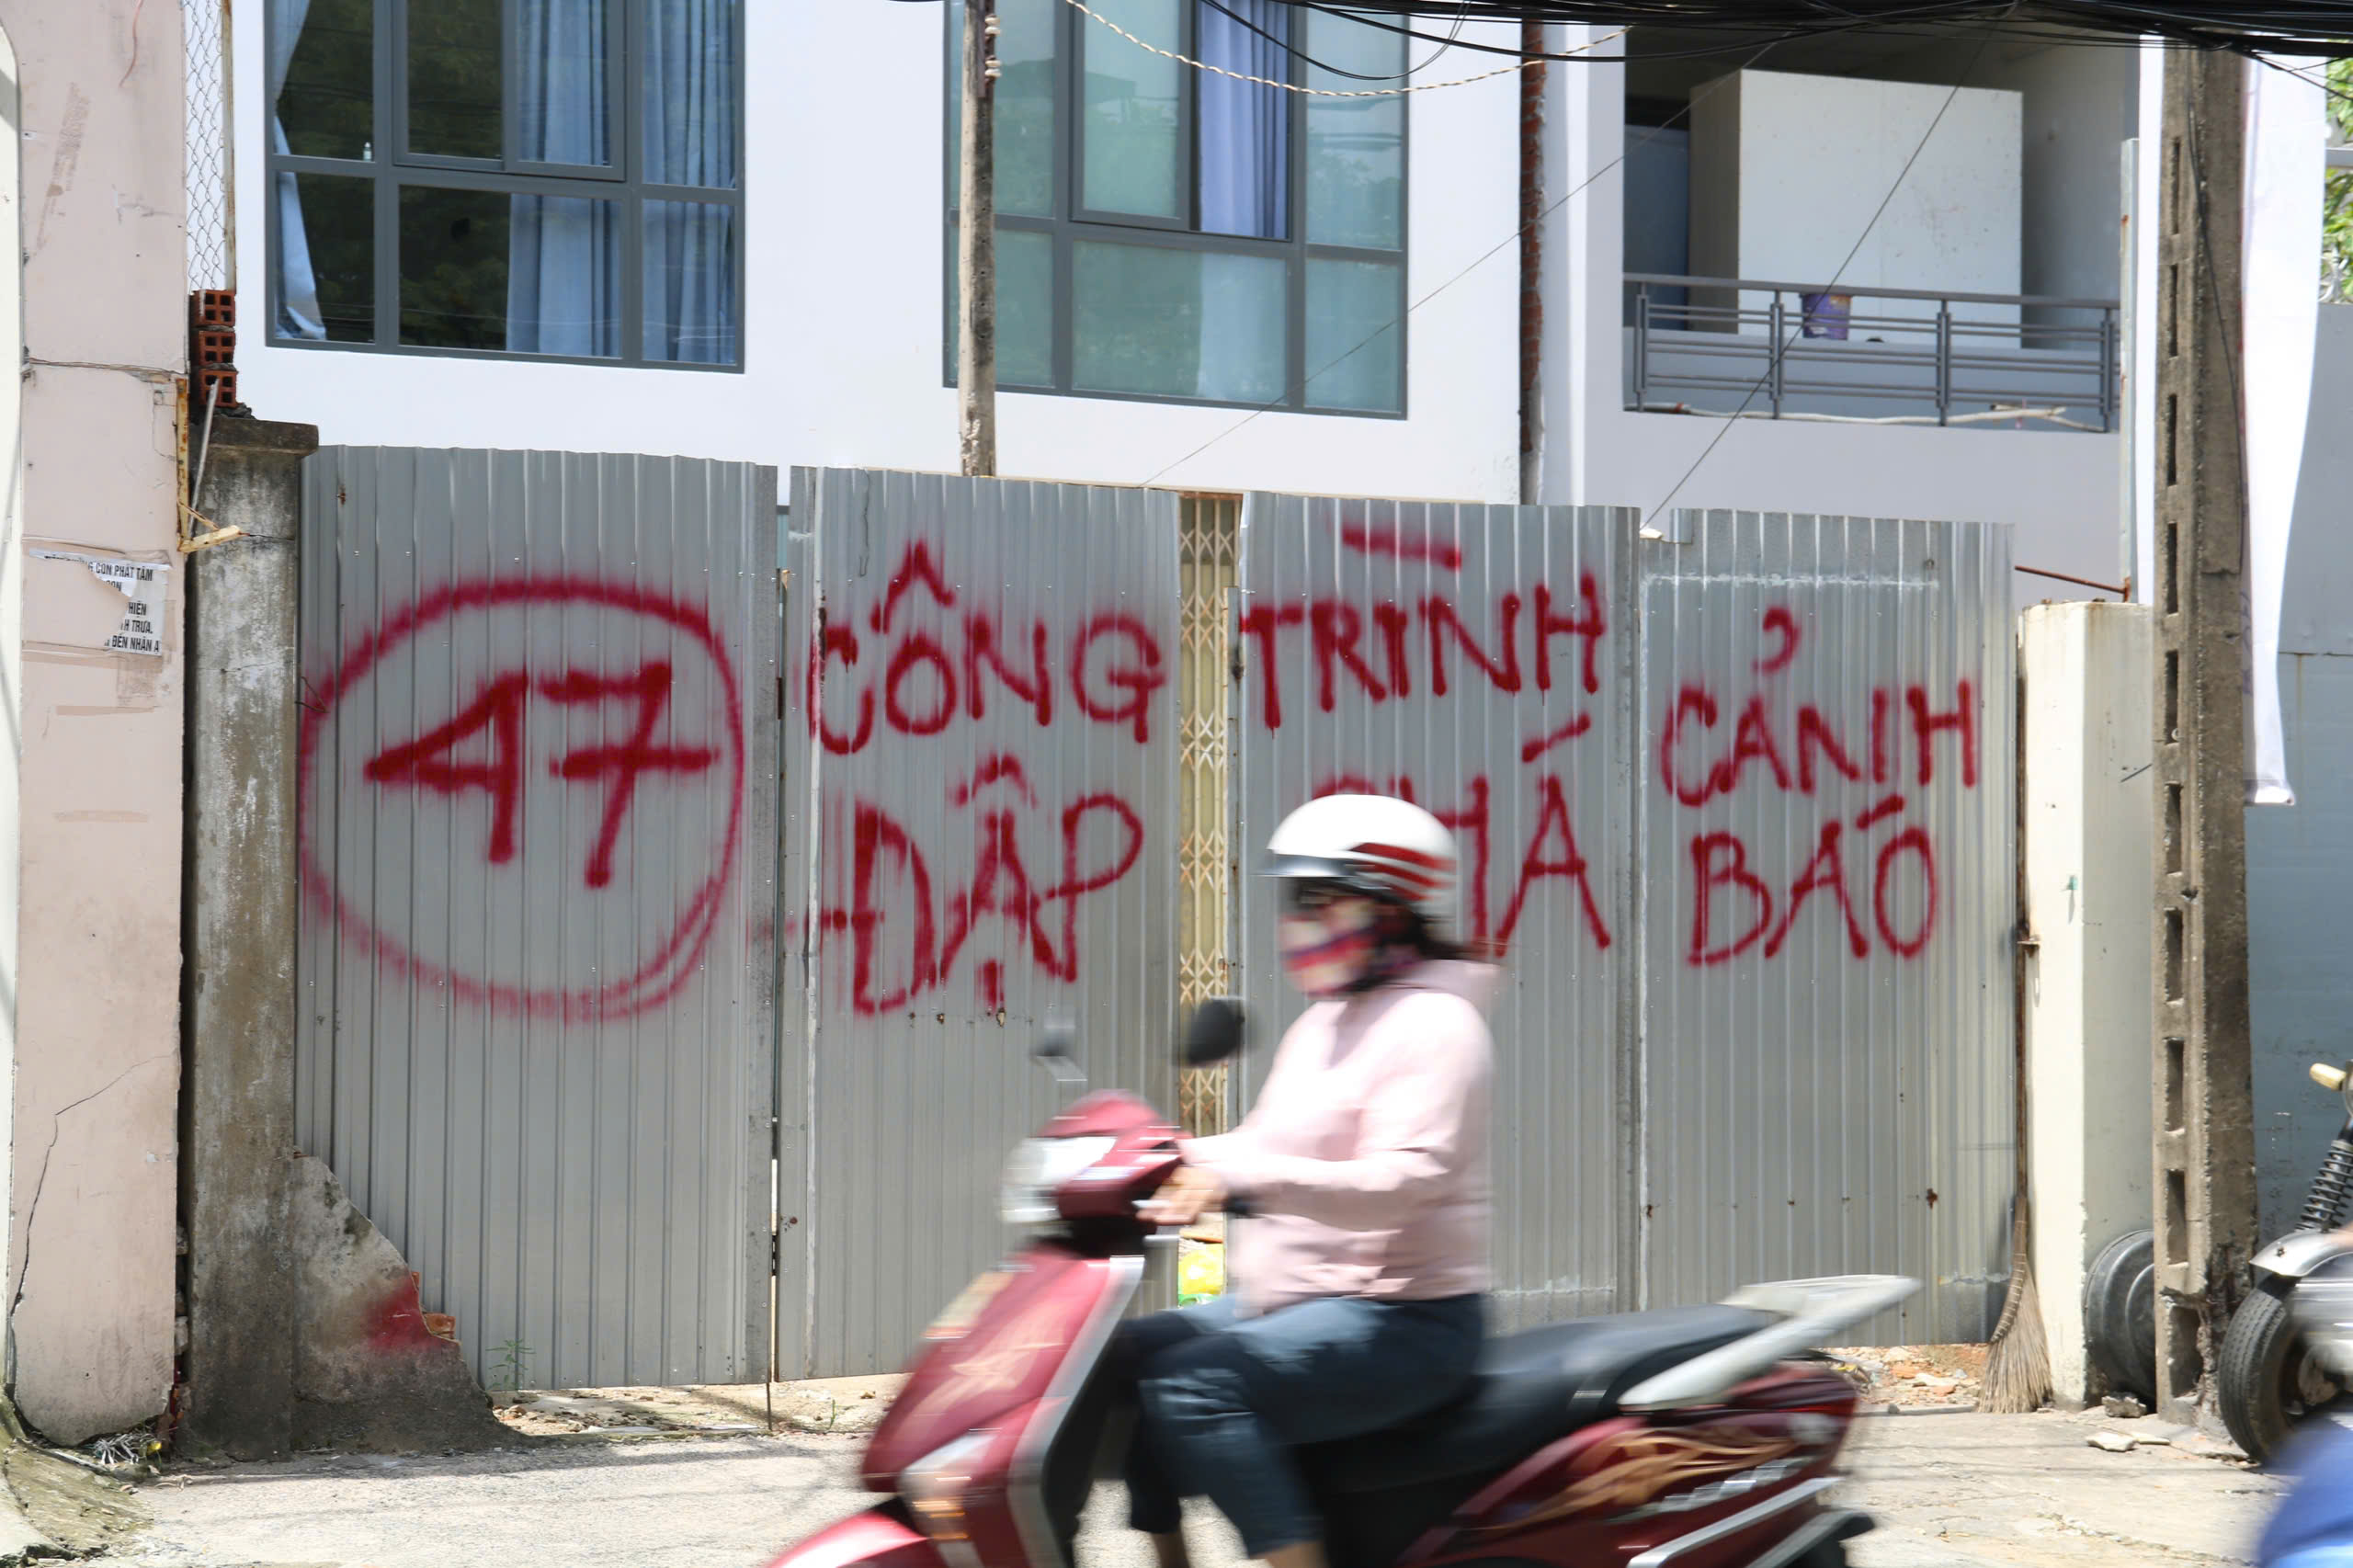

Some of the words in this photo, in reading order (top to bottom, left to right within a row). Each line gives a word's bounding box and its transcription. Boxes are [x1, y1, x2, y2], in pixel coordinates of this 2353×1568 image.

[135, 565, 153, 582] TÂM
[806, 539, 1165, 755] CÔNG
[1238, 520, 1607, 735] TRÌNH
[366, 658, 717, 890] 47
[801, 752, 1144, 1017] ĐẬP
[1311, 711, 1611, 959] HÁ
[1685, 794, 1938, 965] BÁO
